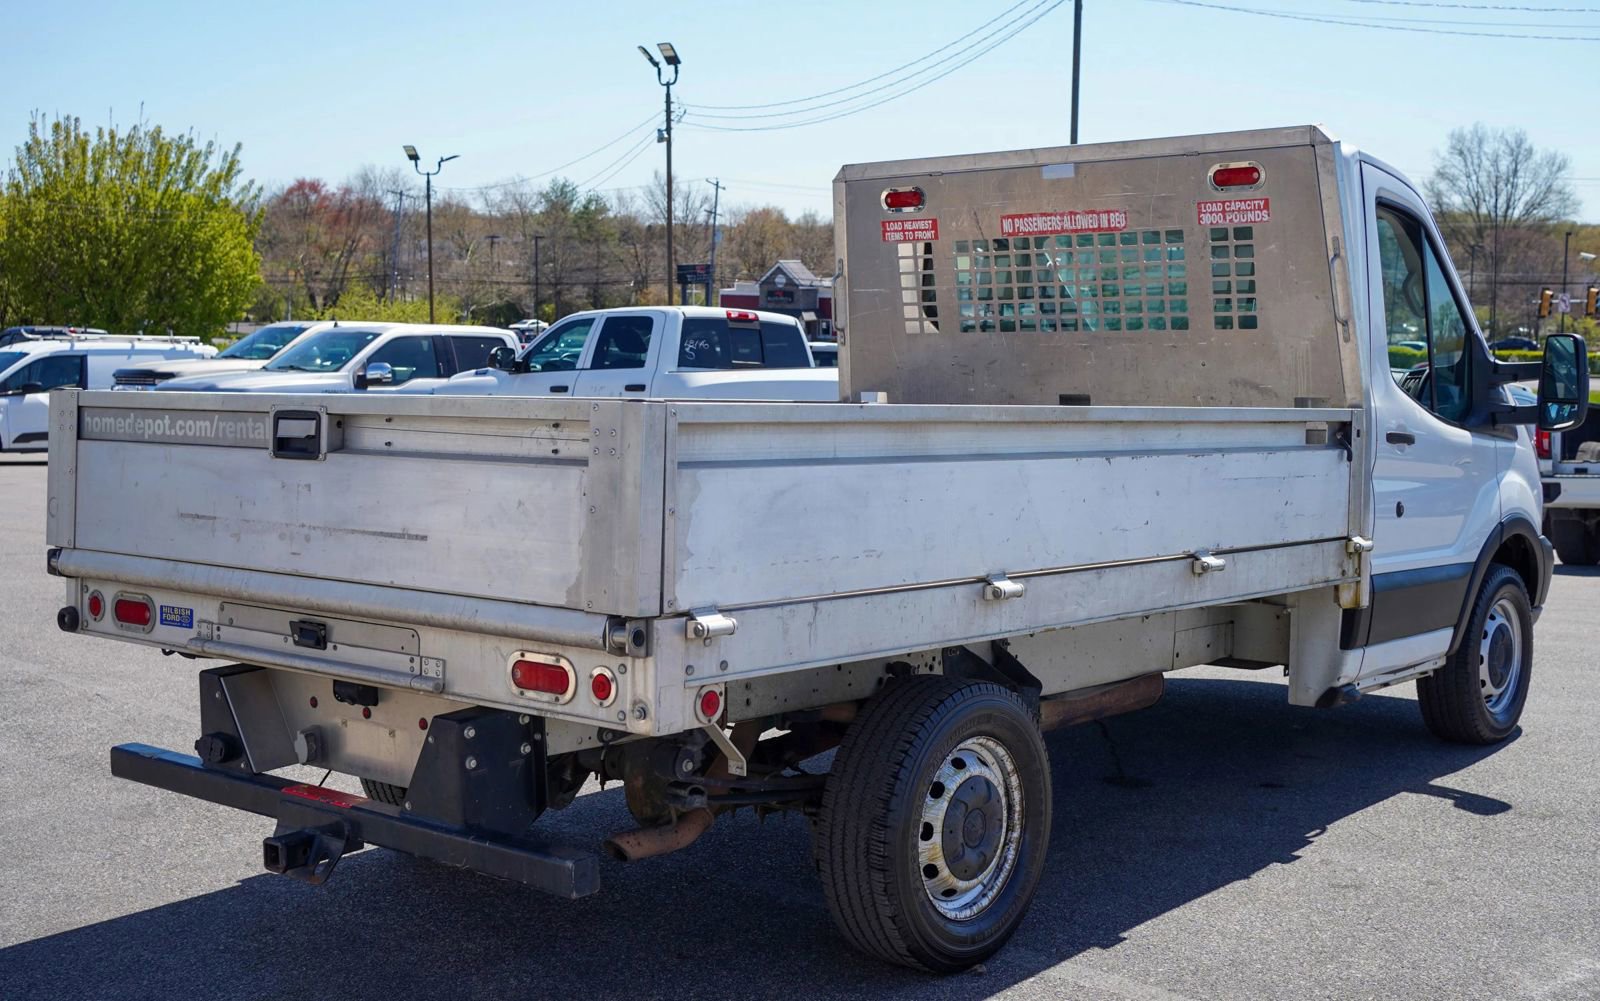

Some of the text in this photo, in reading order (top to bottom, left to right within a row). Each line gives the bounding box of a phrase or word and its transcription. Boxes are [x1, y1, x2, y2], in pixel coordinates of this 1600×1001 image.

[1201, 200, 1265, 213] LOAD CAPACITY
[1002, 212, 1127, 233] NO PASSENGERS ALLOWED IN BED
[1199, 210, 1270, 225] 3000 POUNDS
[885, 220, 933, 231] LOAD HEAVIEST
[885, 230, 936, 241] ITEMS TO FRONT
[162, 605, 191, 616] HILBISH
[162, 613, 180, 622] FORD
